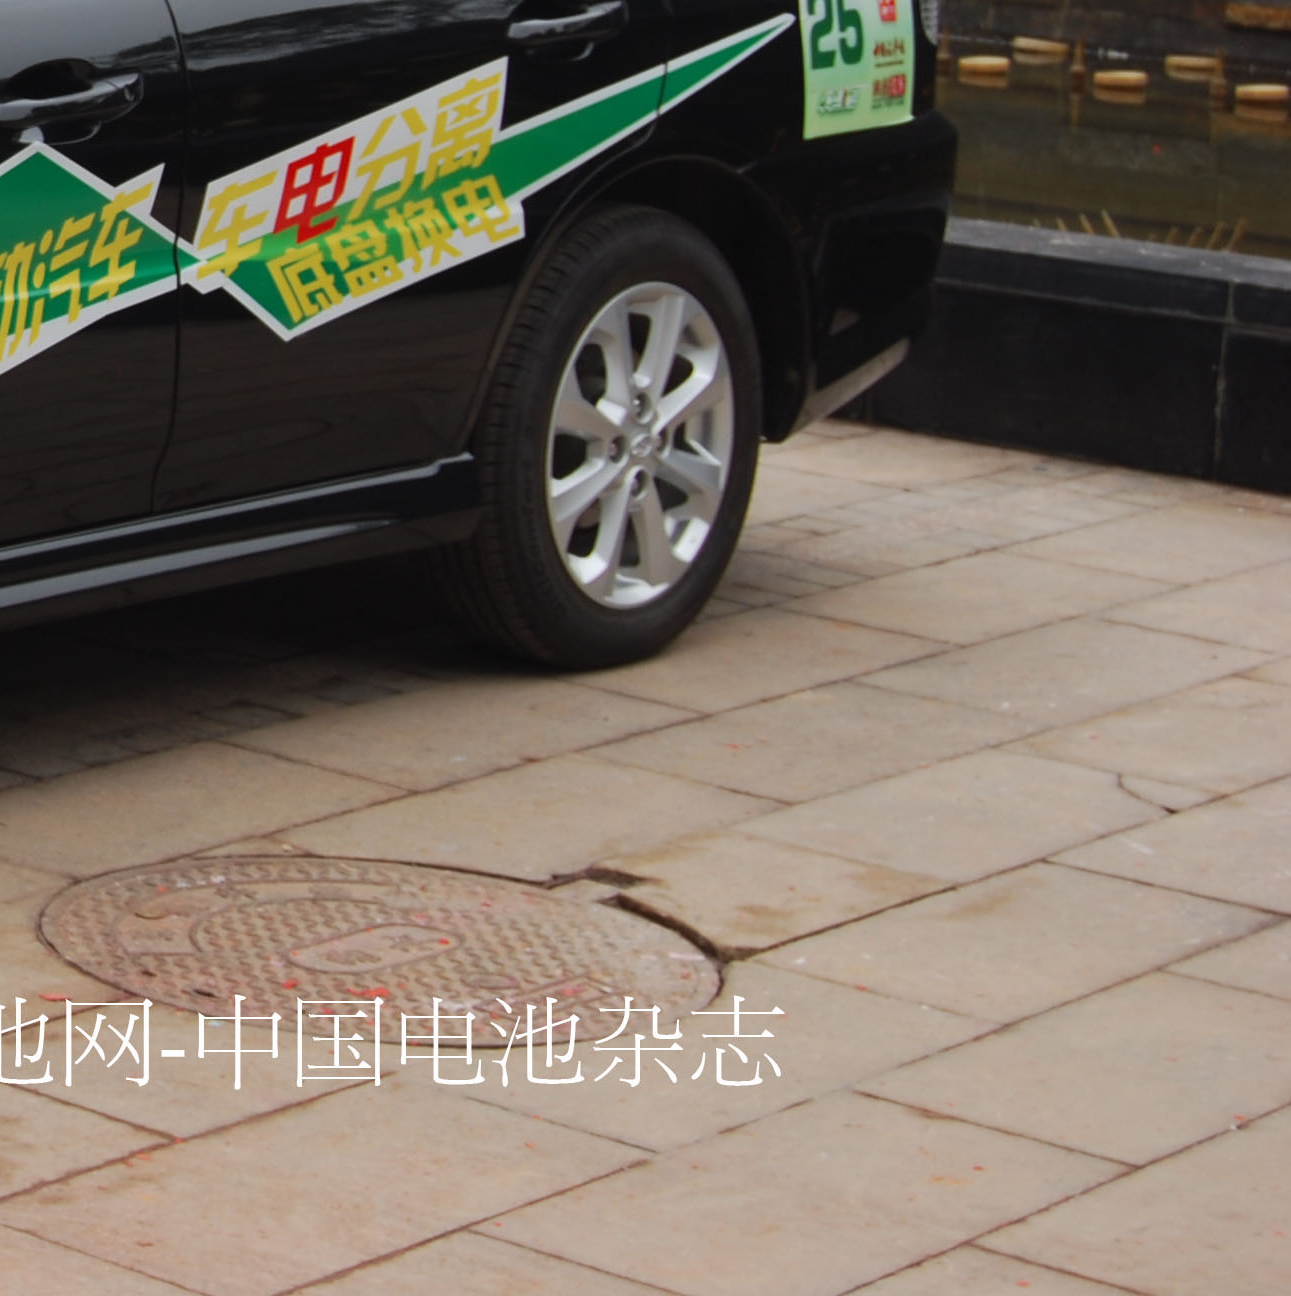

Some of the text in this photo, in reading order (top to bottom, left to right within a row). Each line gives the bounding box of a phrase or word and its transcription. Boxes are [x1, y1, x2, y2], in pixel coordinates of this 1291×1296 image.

[195, 70, 504, 281] 车电分离
[267, 173, 522, 325] 底盘换电
